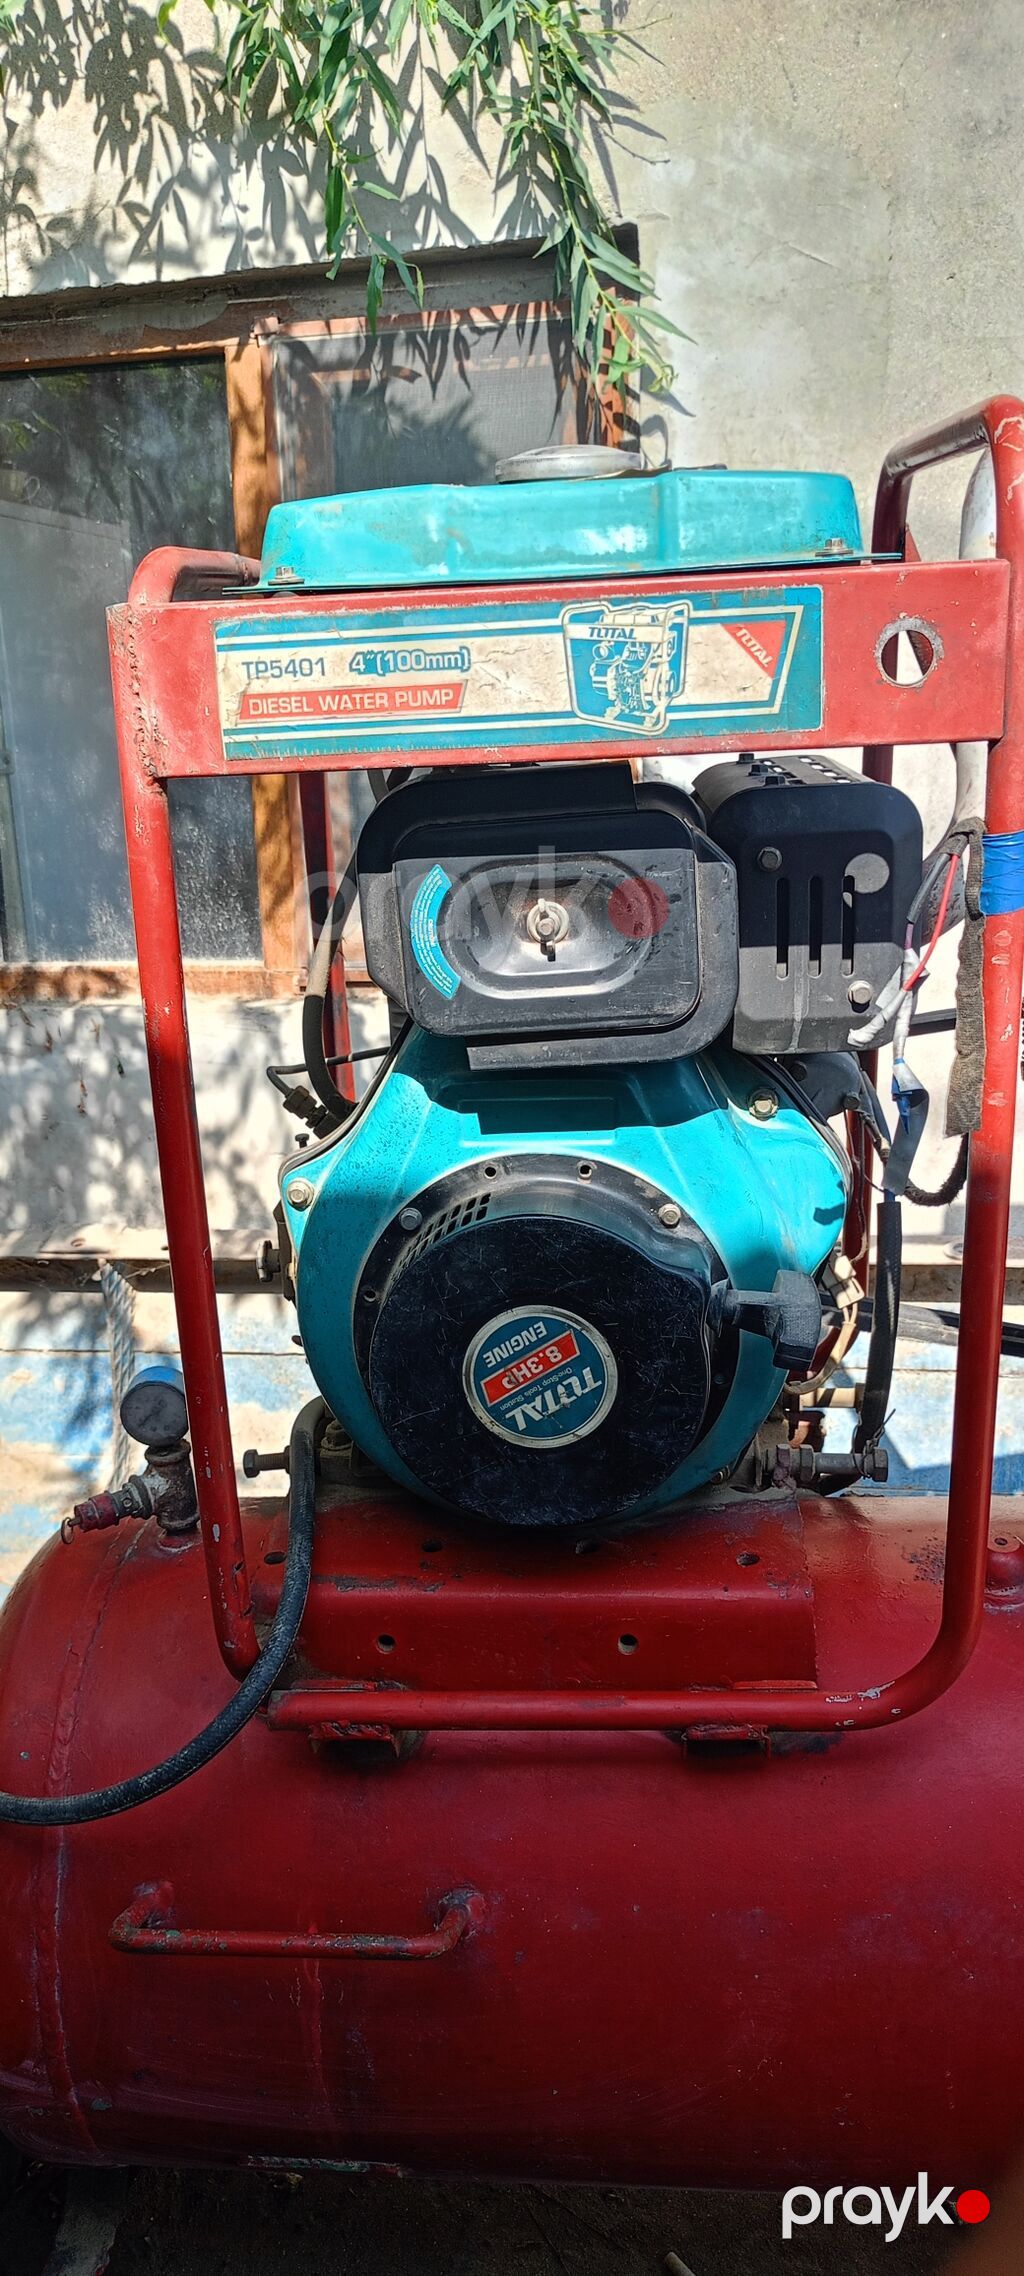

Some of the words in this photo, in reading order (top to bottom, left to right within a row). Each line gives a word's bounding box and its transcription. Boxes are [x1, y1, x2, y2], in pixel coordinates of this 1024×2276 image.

[588, 626, 637, 640] TOTAL
[735, 628, 774, 668] TOTAL
[242, 657, 325, 680] TP5401
[249, 697, 313, 716] DIESEL
[318, 692, 389, 712] WATER
[395, 688, 454, 708] PUMP
[482, 1321, 548, 1368] ENGINE
[501, 1345, 563, 1389] 8.3HP
[500, 1394, 525, 1411] Station
[505, 1366, 602, 1431] TOTAL
